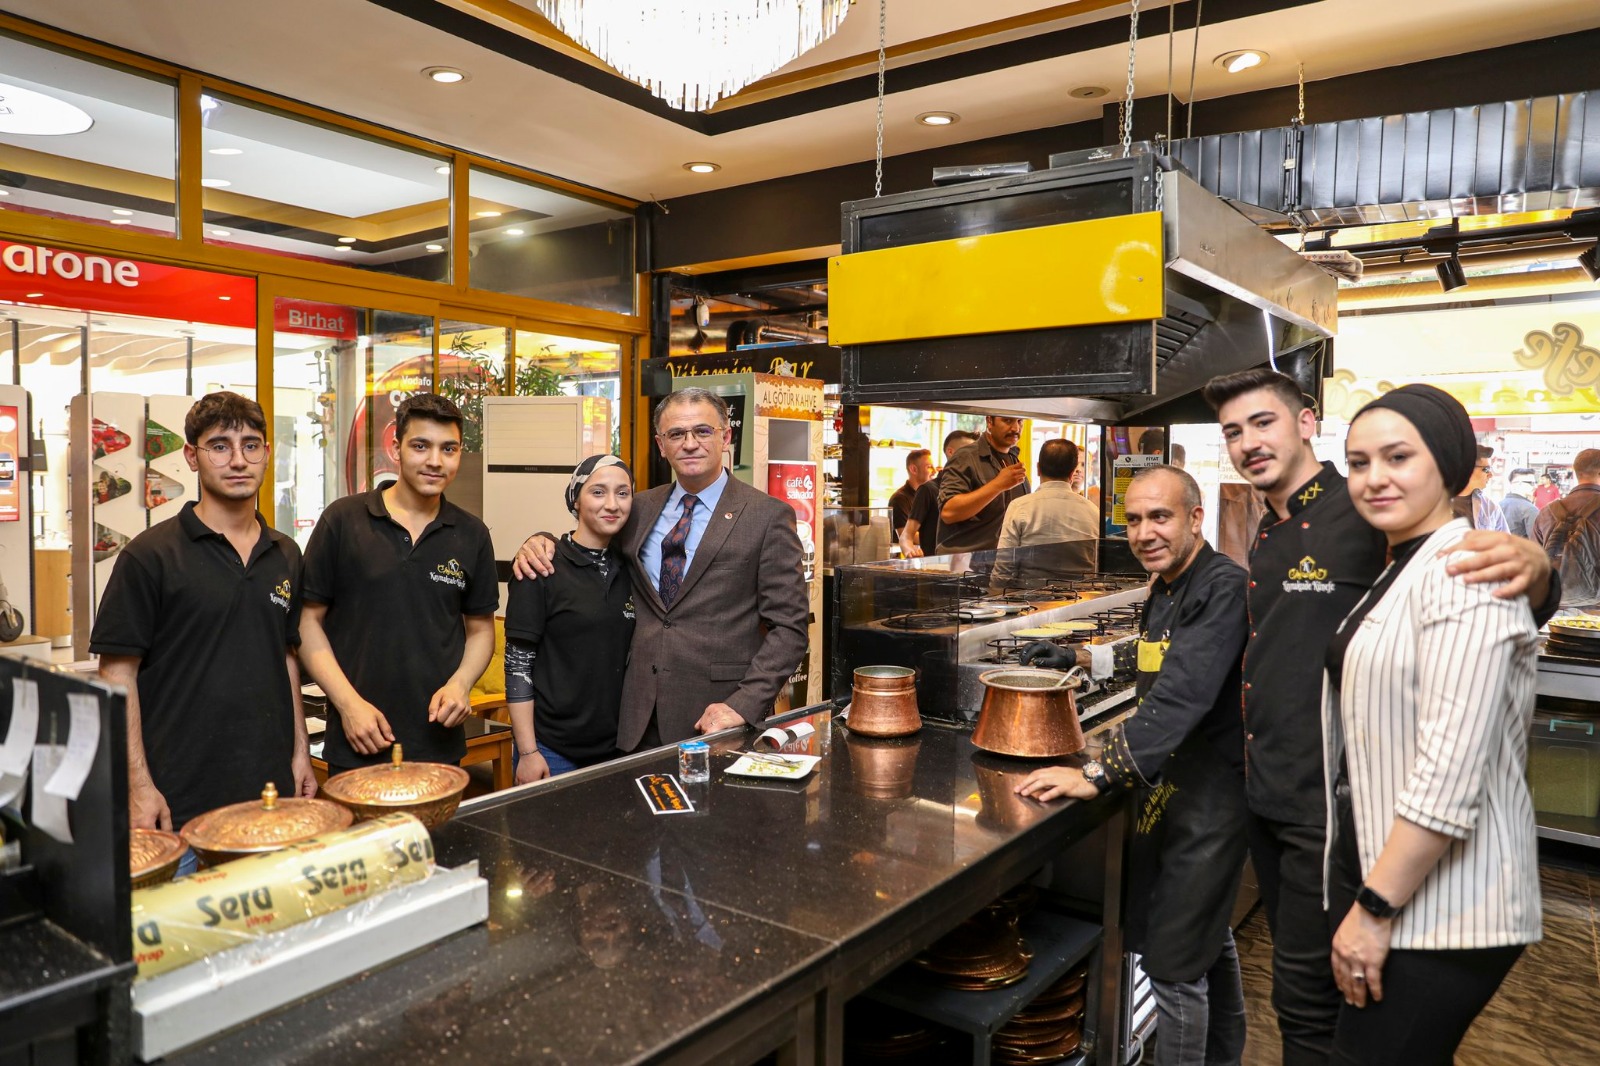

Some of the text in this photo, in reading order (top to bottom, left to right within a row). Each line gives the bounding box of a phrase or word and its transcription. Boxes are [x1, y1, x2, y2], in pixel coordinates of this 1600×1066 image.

[288, 309, 344, 331] Birhat
[763, 388, 817, 409] AL GÖTÜR KAHVE
[788, 674, 808, 684] Coffee
[302, 858, 368, 896] Sera
[196, 886, 273, 928] Sera
